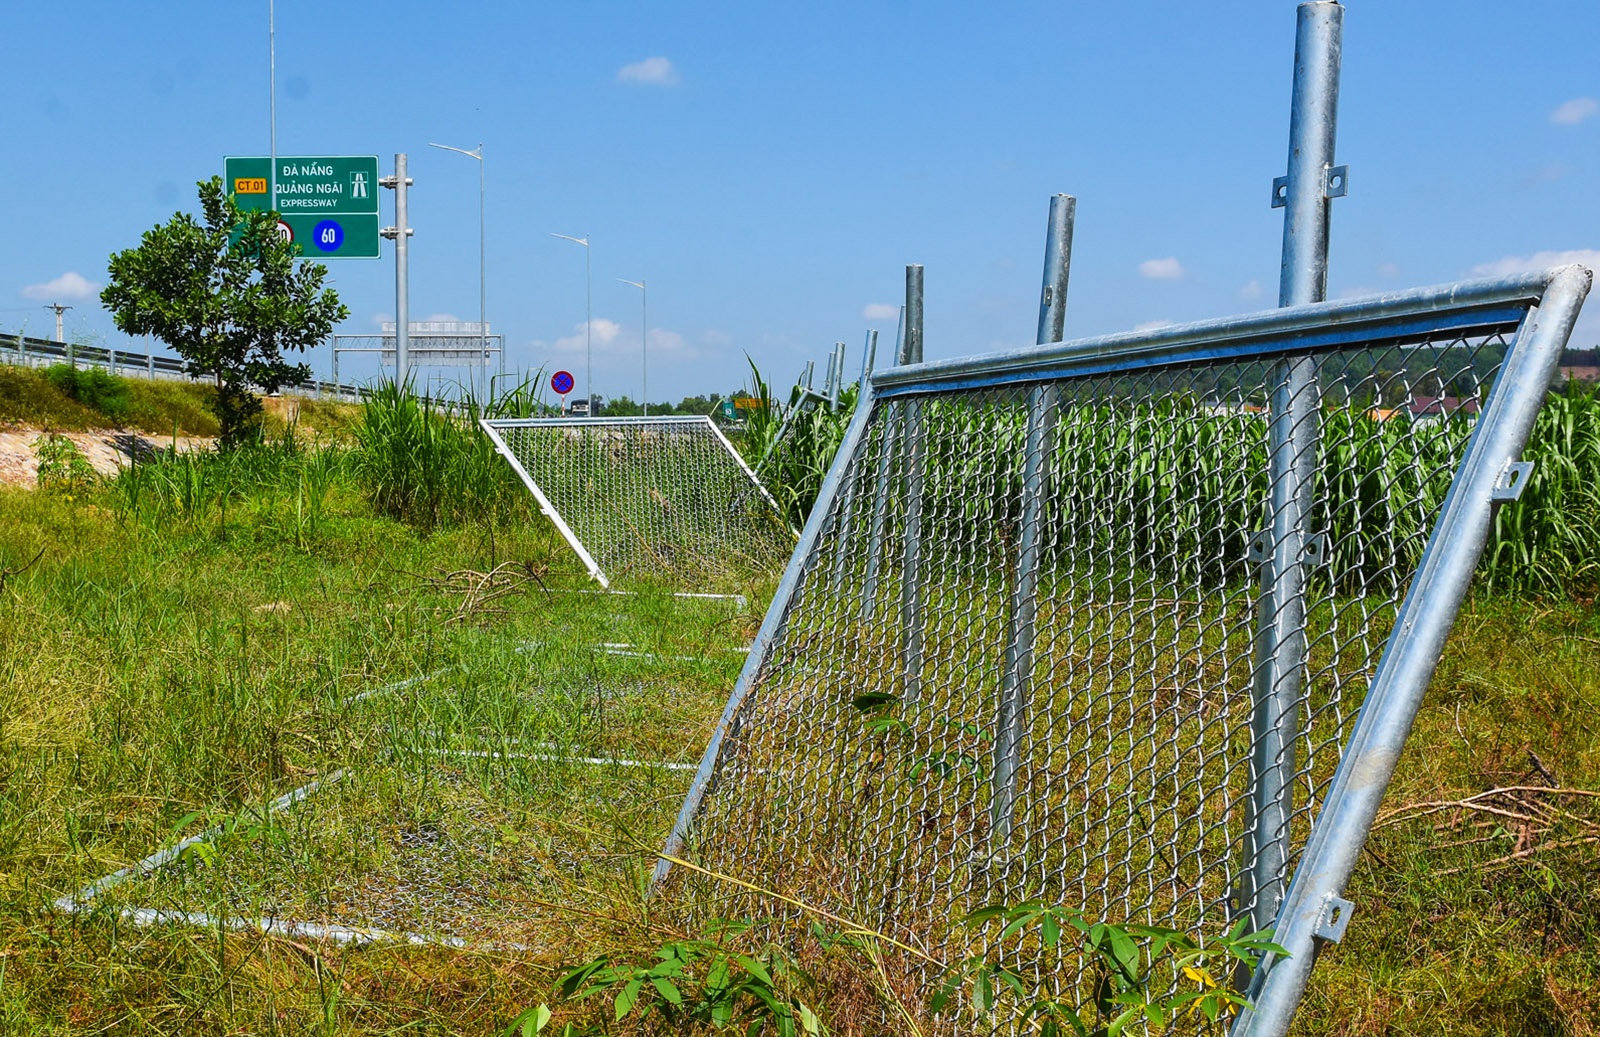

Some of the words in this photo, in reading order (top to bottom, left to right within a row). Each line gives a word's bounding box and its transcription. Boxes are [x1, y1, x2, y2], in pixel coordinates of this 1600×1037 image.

[283, 163, 299, 176] ĐÀ
[238, 181, 264, 191] CT.01
[275, 180, 313, 194] QUẢNG
[316, 181, 343, 194] NGÃI
[280, 199, 337, 207] EXPRESSWAY
[321, 228, 335, 243] 60
